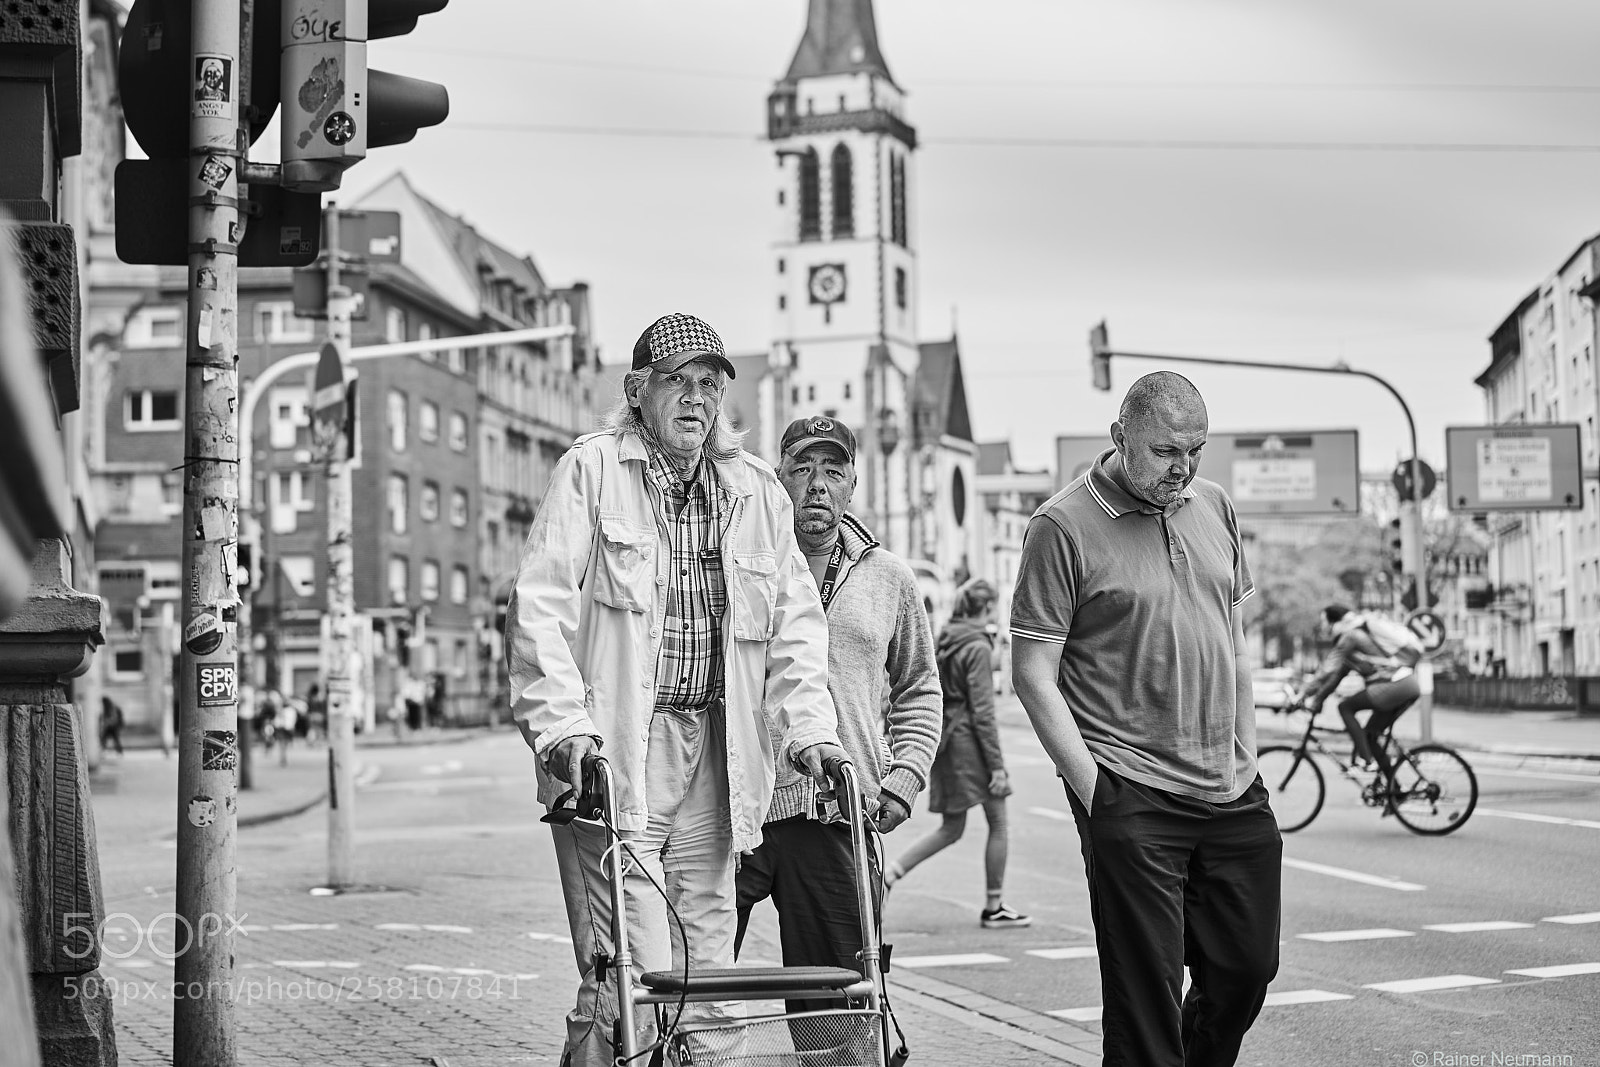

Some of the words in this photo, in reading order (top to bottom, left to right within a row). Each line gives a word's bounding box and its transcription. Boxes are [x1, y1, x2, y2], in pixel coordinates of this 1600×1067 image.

[199, 102, 224, 110] ANGST
[200, 667, 234, 683] SPR
[200, 682, 233, 698] CPY
